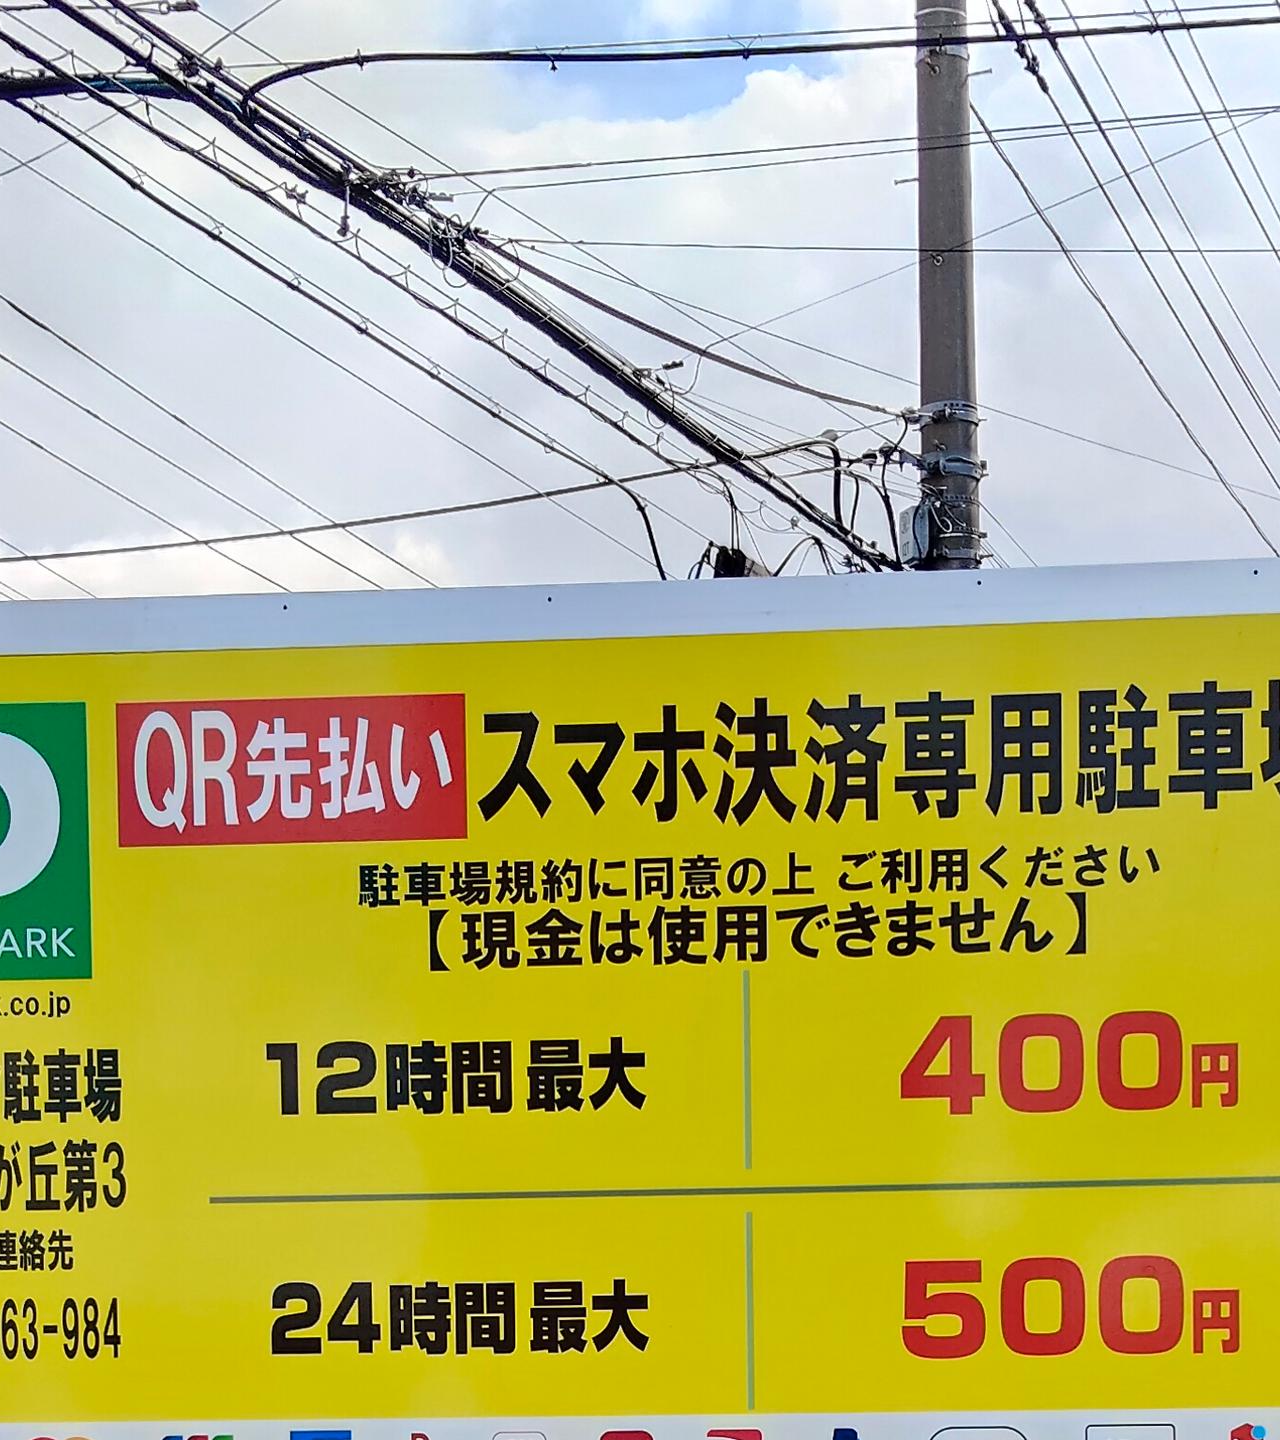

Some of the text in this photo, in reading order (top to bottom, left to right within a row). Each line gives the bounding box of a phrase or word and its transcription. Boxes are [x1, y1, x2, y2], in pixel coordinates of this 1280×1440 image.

[134, 711, 452, 833] QR先払い
[359, 845, 1159, 907] 駐車場規約に同意の上 ご利用ください
[429, 886, 1086, 971] 【現金は使用できません】
[901, 1011, 1238, 1114] 400円
[902, 1256, 1239, 1359] 500円
